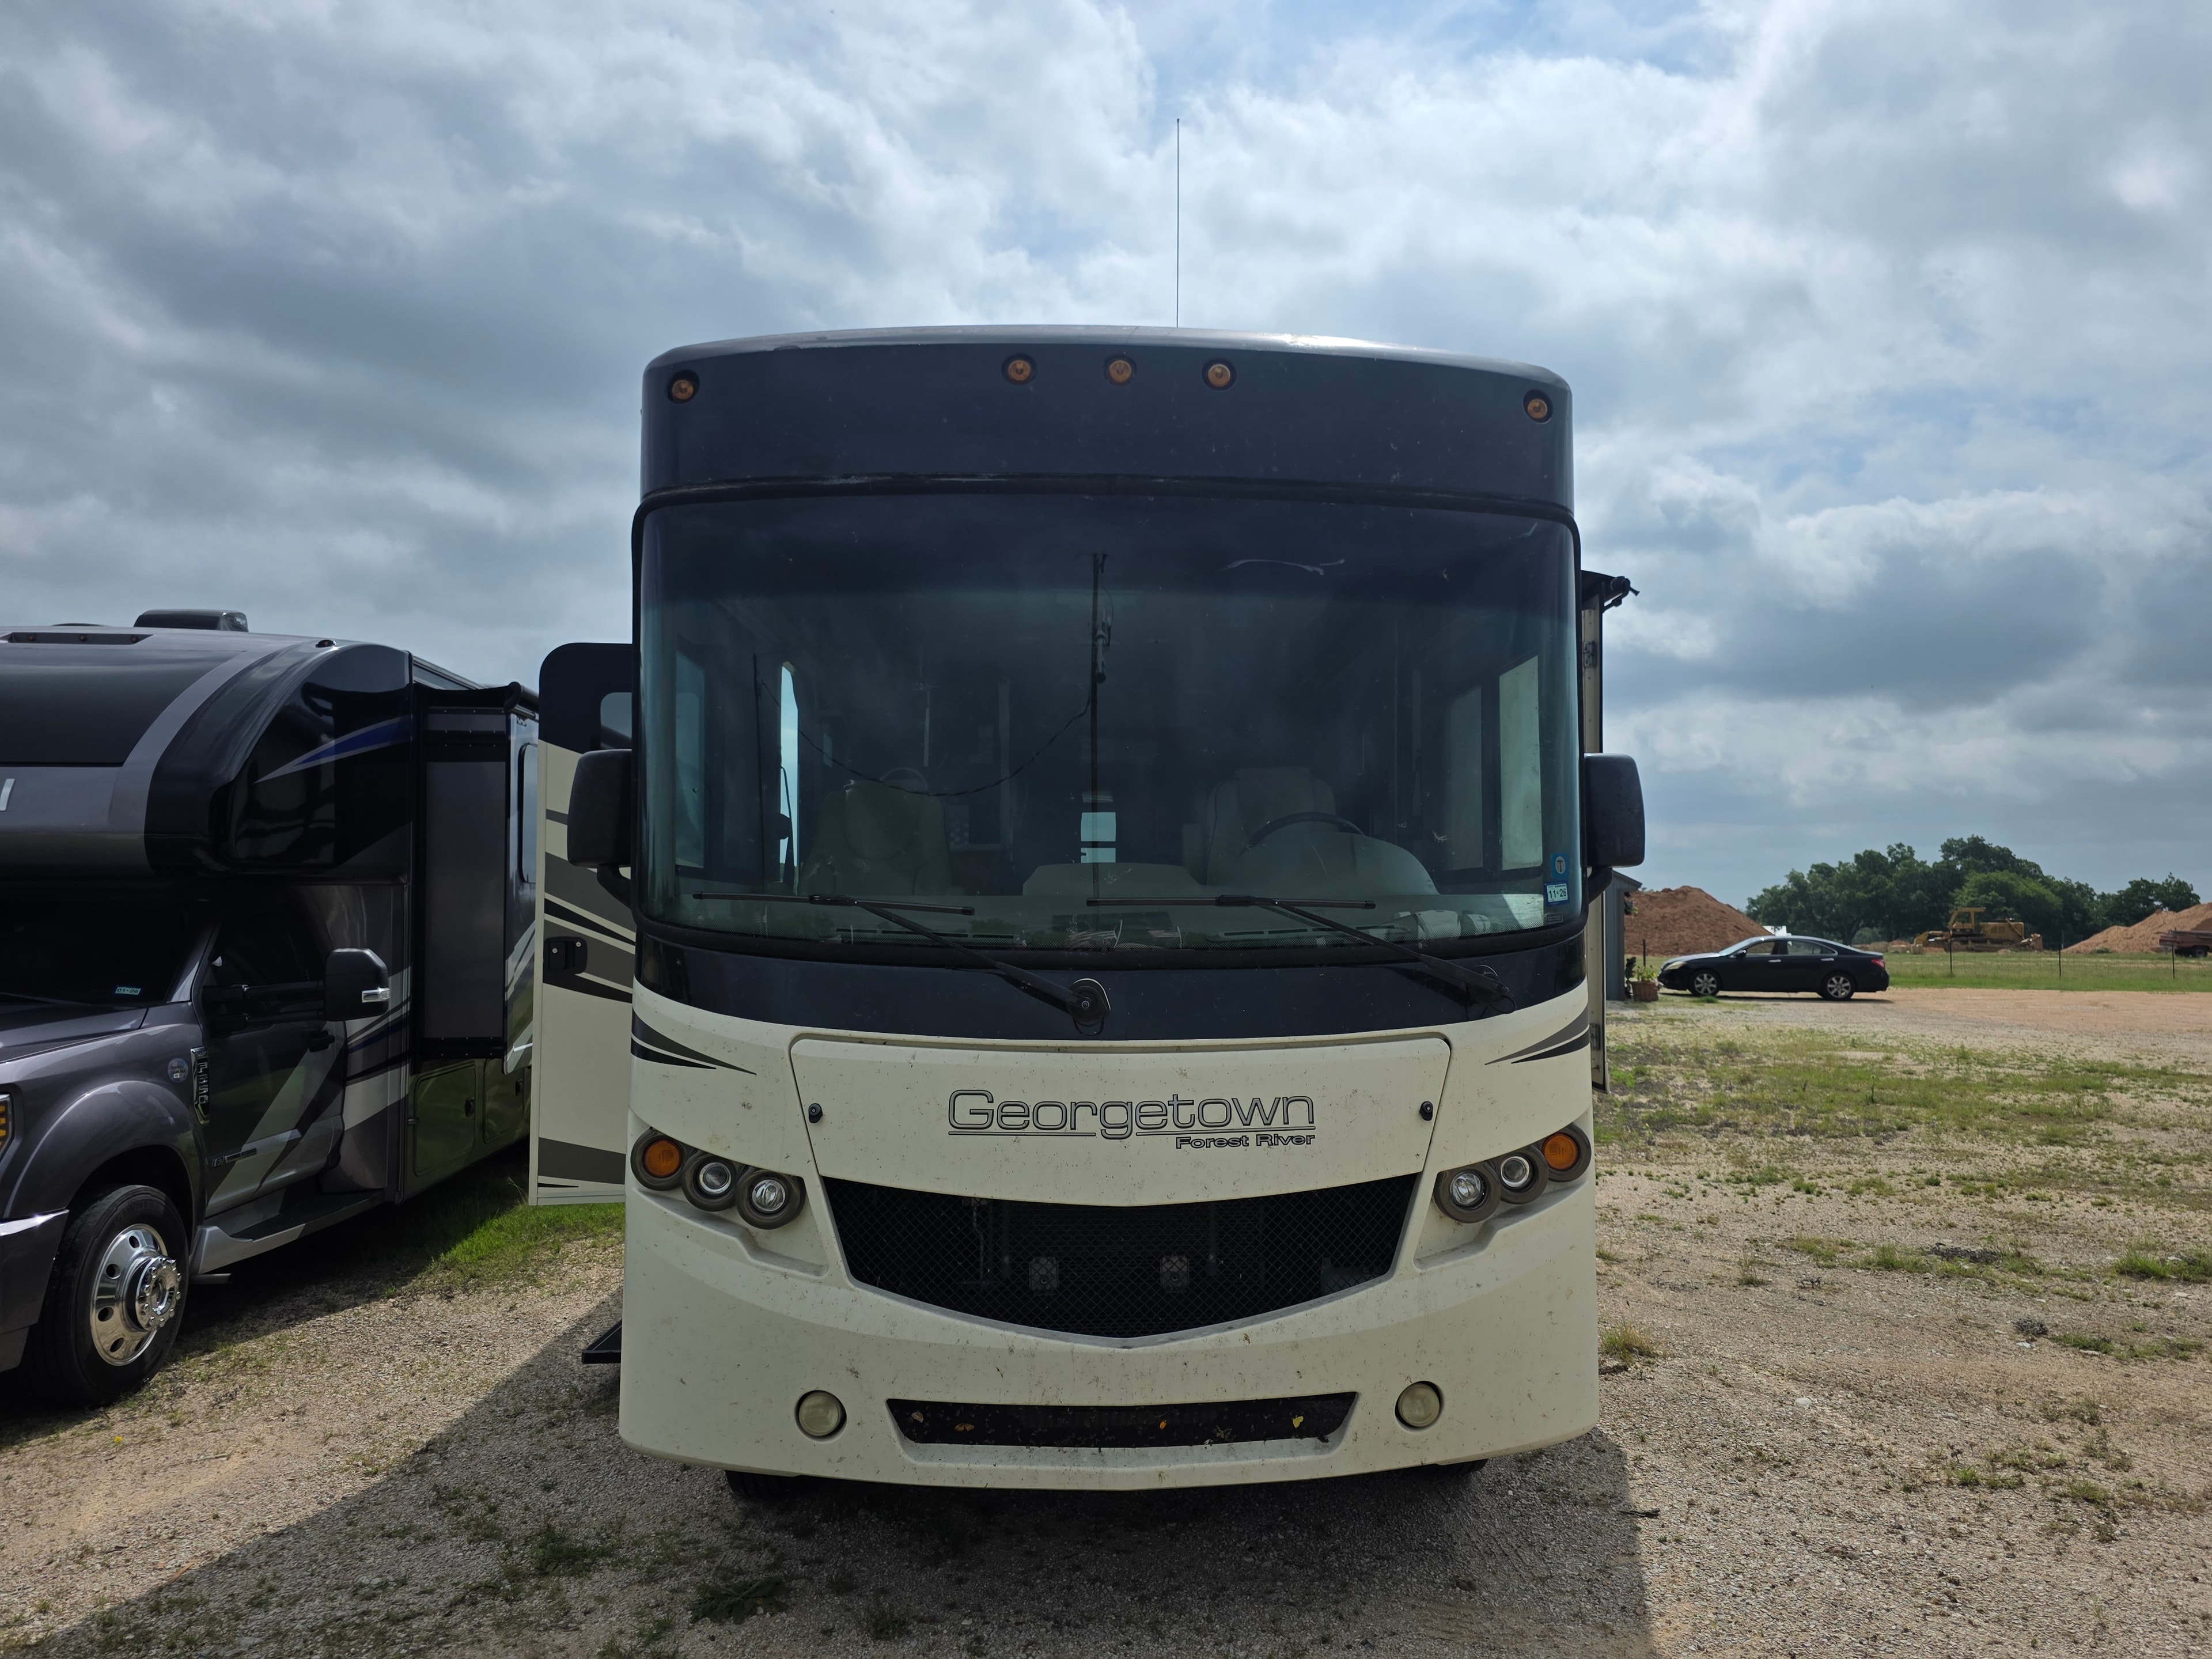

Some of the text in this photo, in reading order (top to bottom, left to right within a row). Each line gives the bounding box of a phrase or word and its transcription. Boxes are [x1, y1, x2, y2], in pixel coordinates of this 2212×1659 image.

[1549, 888, 1566, 899] 11 26
[948, 1089, 1314, 1140] Georgetown
[1176, 1134, 1315, 1149] Forest River
